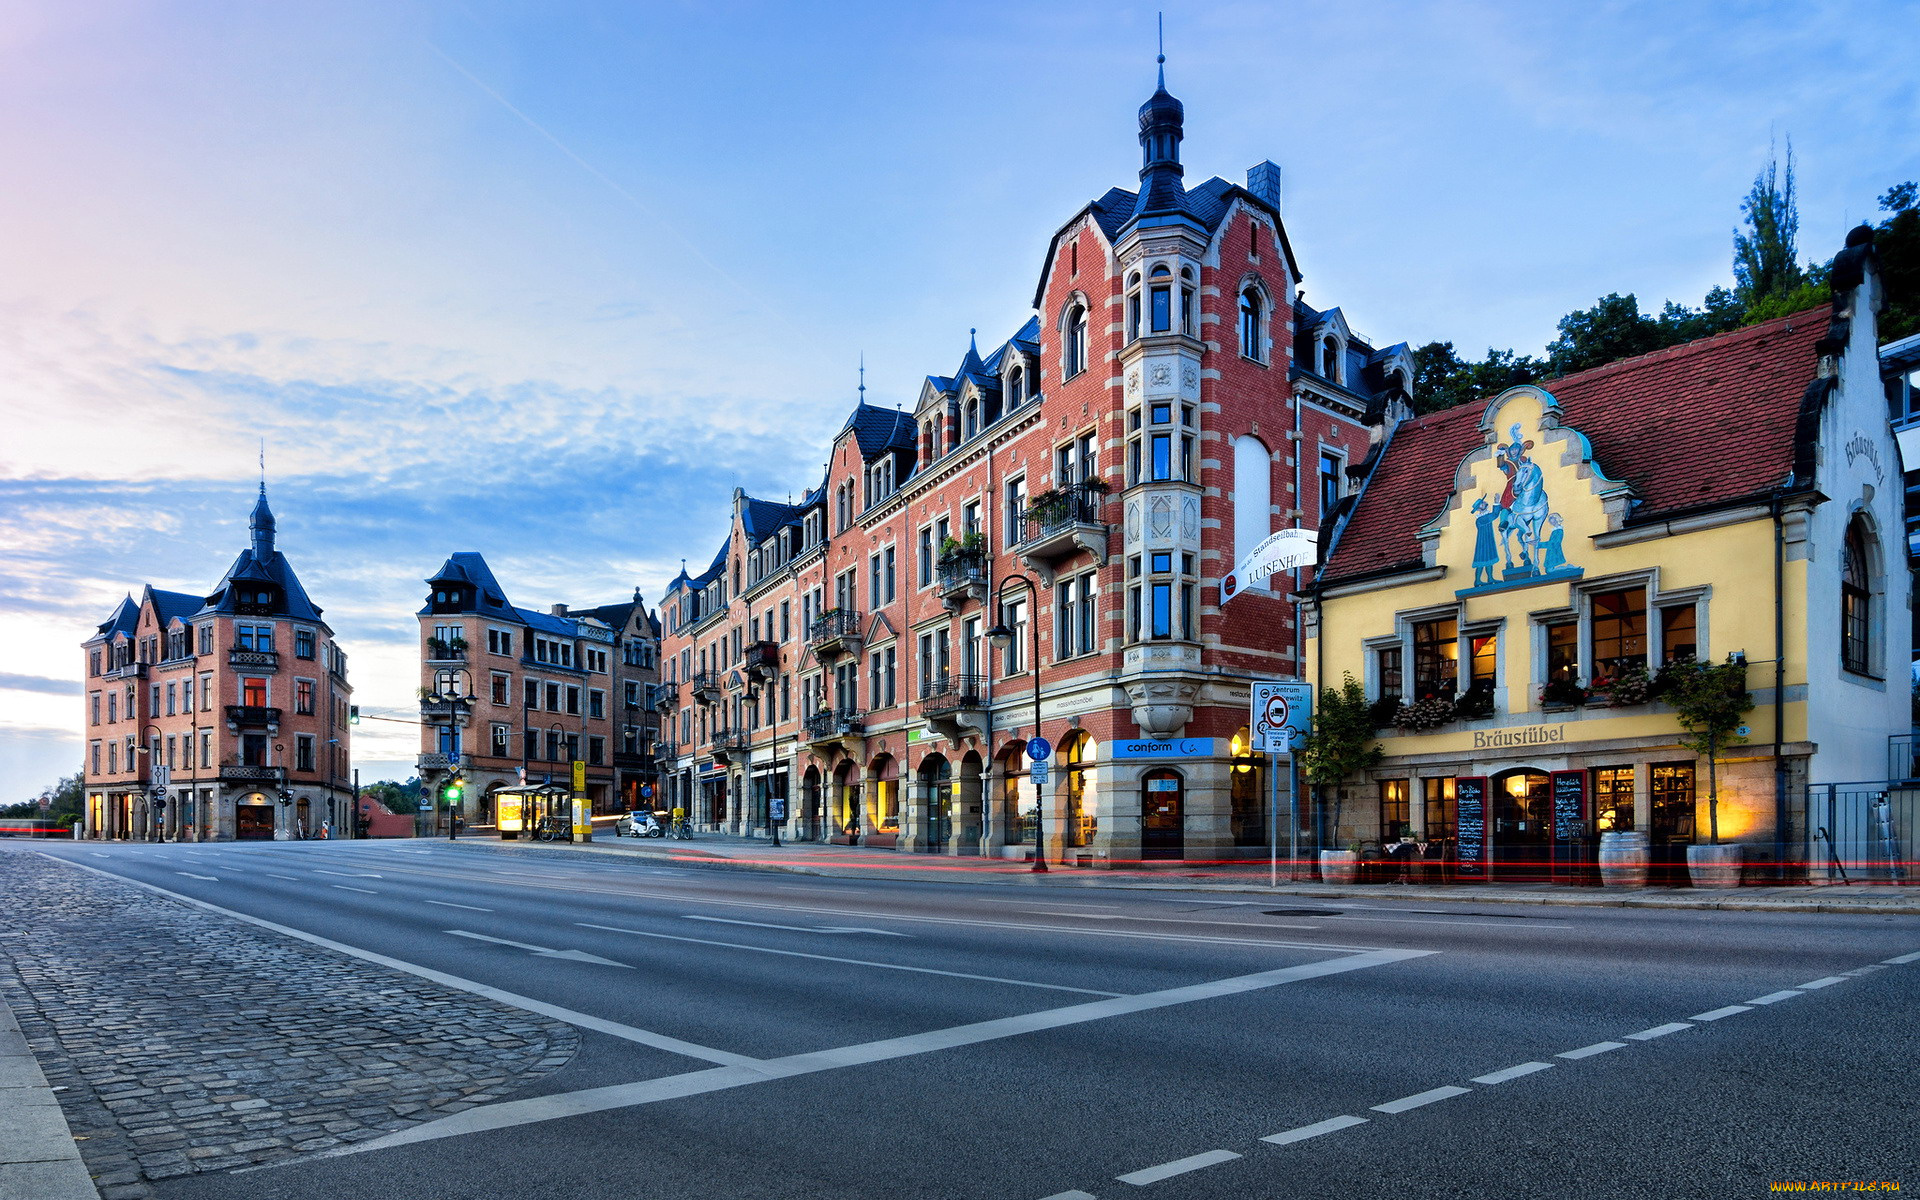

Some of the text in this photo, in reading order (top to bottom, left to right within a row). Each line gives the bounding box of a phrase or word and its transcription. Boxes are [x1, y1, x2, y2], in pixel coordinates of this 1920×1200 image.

[1249, 552, 1309, 585] LUISENHOF
[1127, 739, 1172, 752] conform
[1473, 725, 1564, 748] Bräustübel
